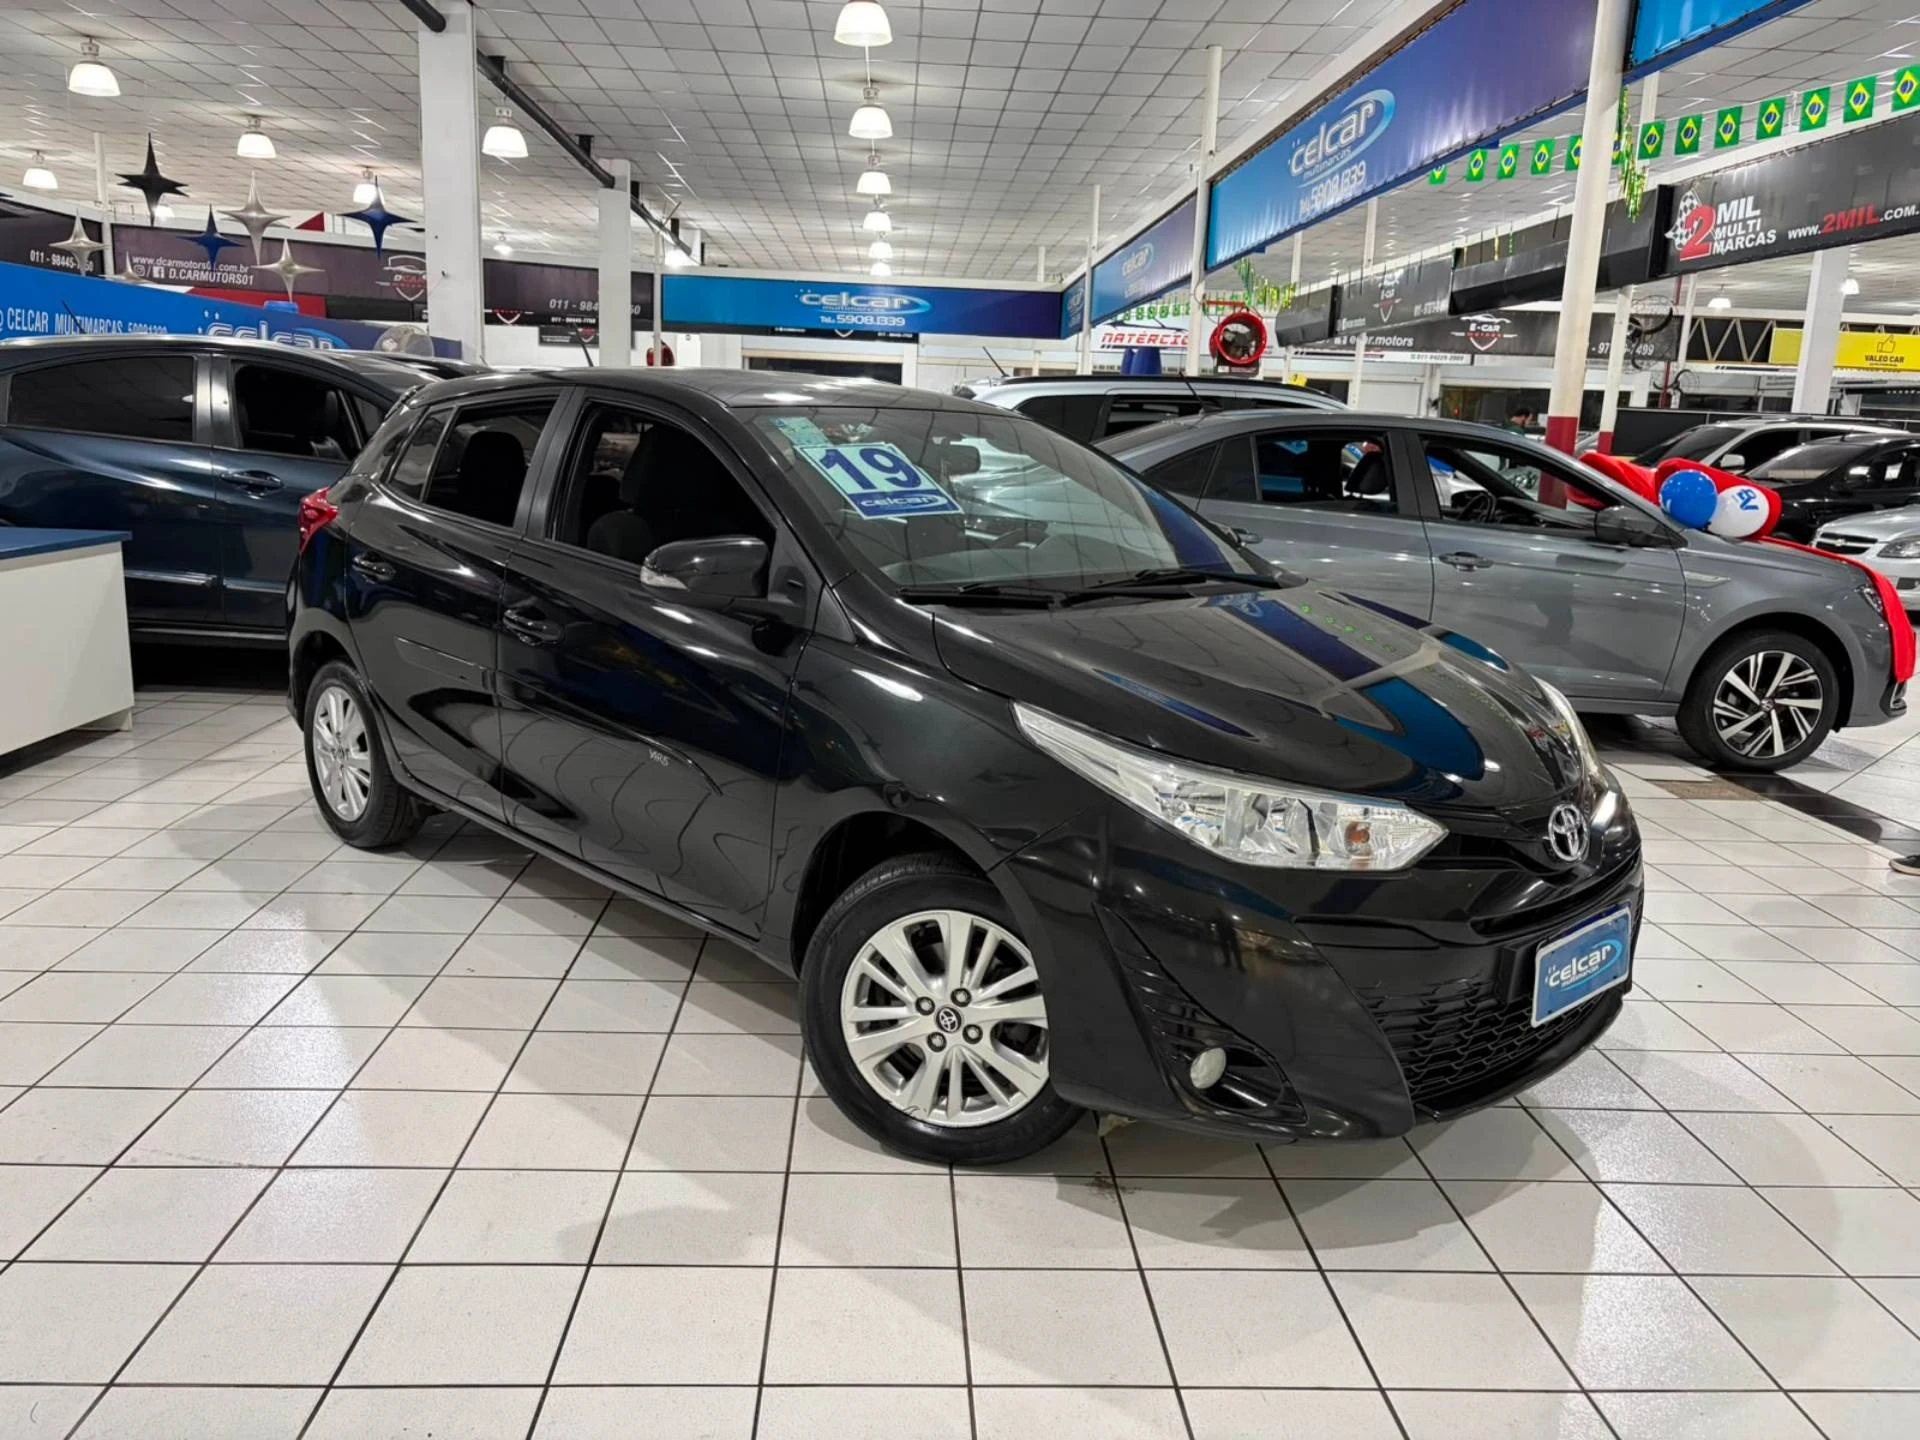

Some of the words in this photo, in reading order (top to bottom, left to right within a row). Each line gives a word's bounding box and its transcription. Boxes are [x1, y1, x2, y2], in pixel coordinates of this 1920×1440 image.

[1291, 100, 1376, 176] celcar
[1680, 204, 1717, 261] 2
[1717, 196, 1761, 224] MIL
[1712, 229, 1777, 255] MARCAS
[1715, 218, 1763, 240] MULTI
[30, 249, 44, 263] 011
[549, 299, 570, 310] 011
[801, 292, 910, 309] celcar
[7, 307, 49, 333] CELCAR
[55, 313, 123, 335] MULTIMARCAS
[820, 448, 922, 490] 19
[1548, 945, 1611, 987] celcar
